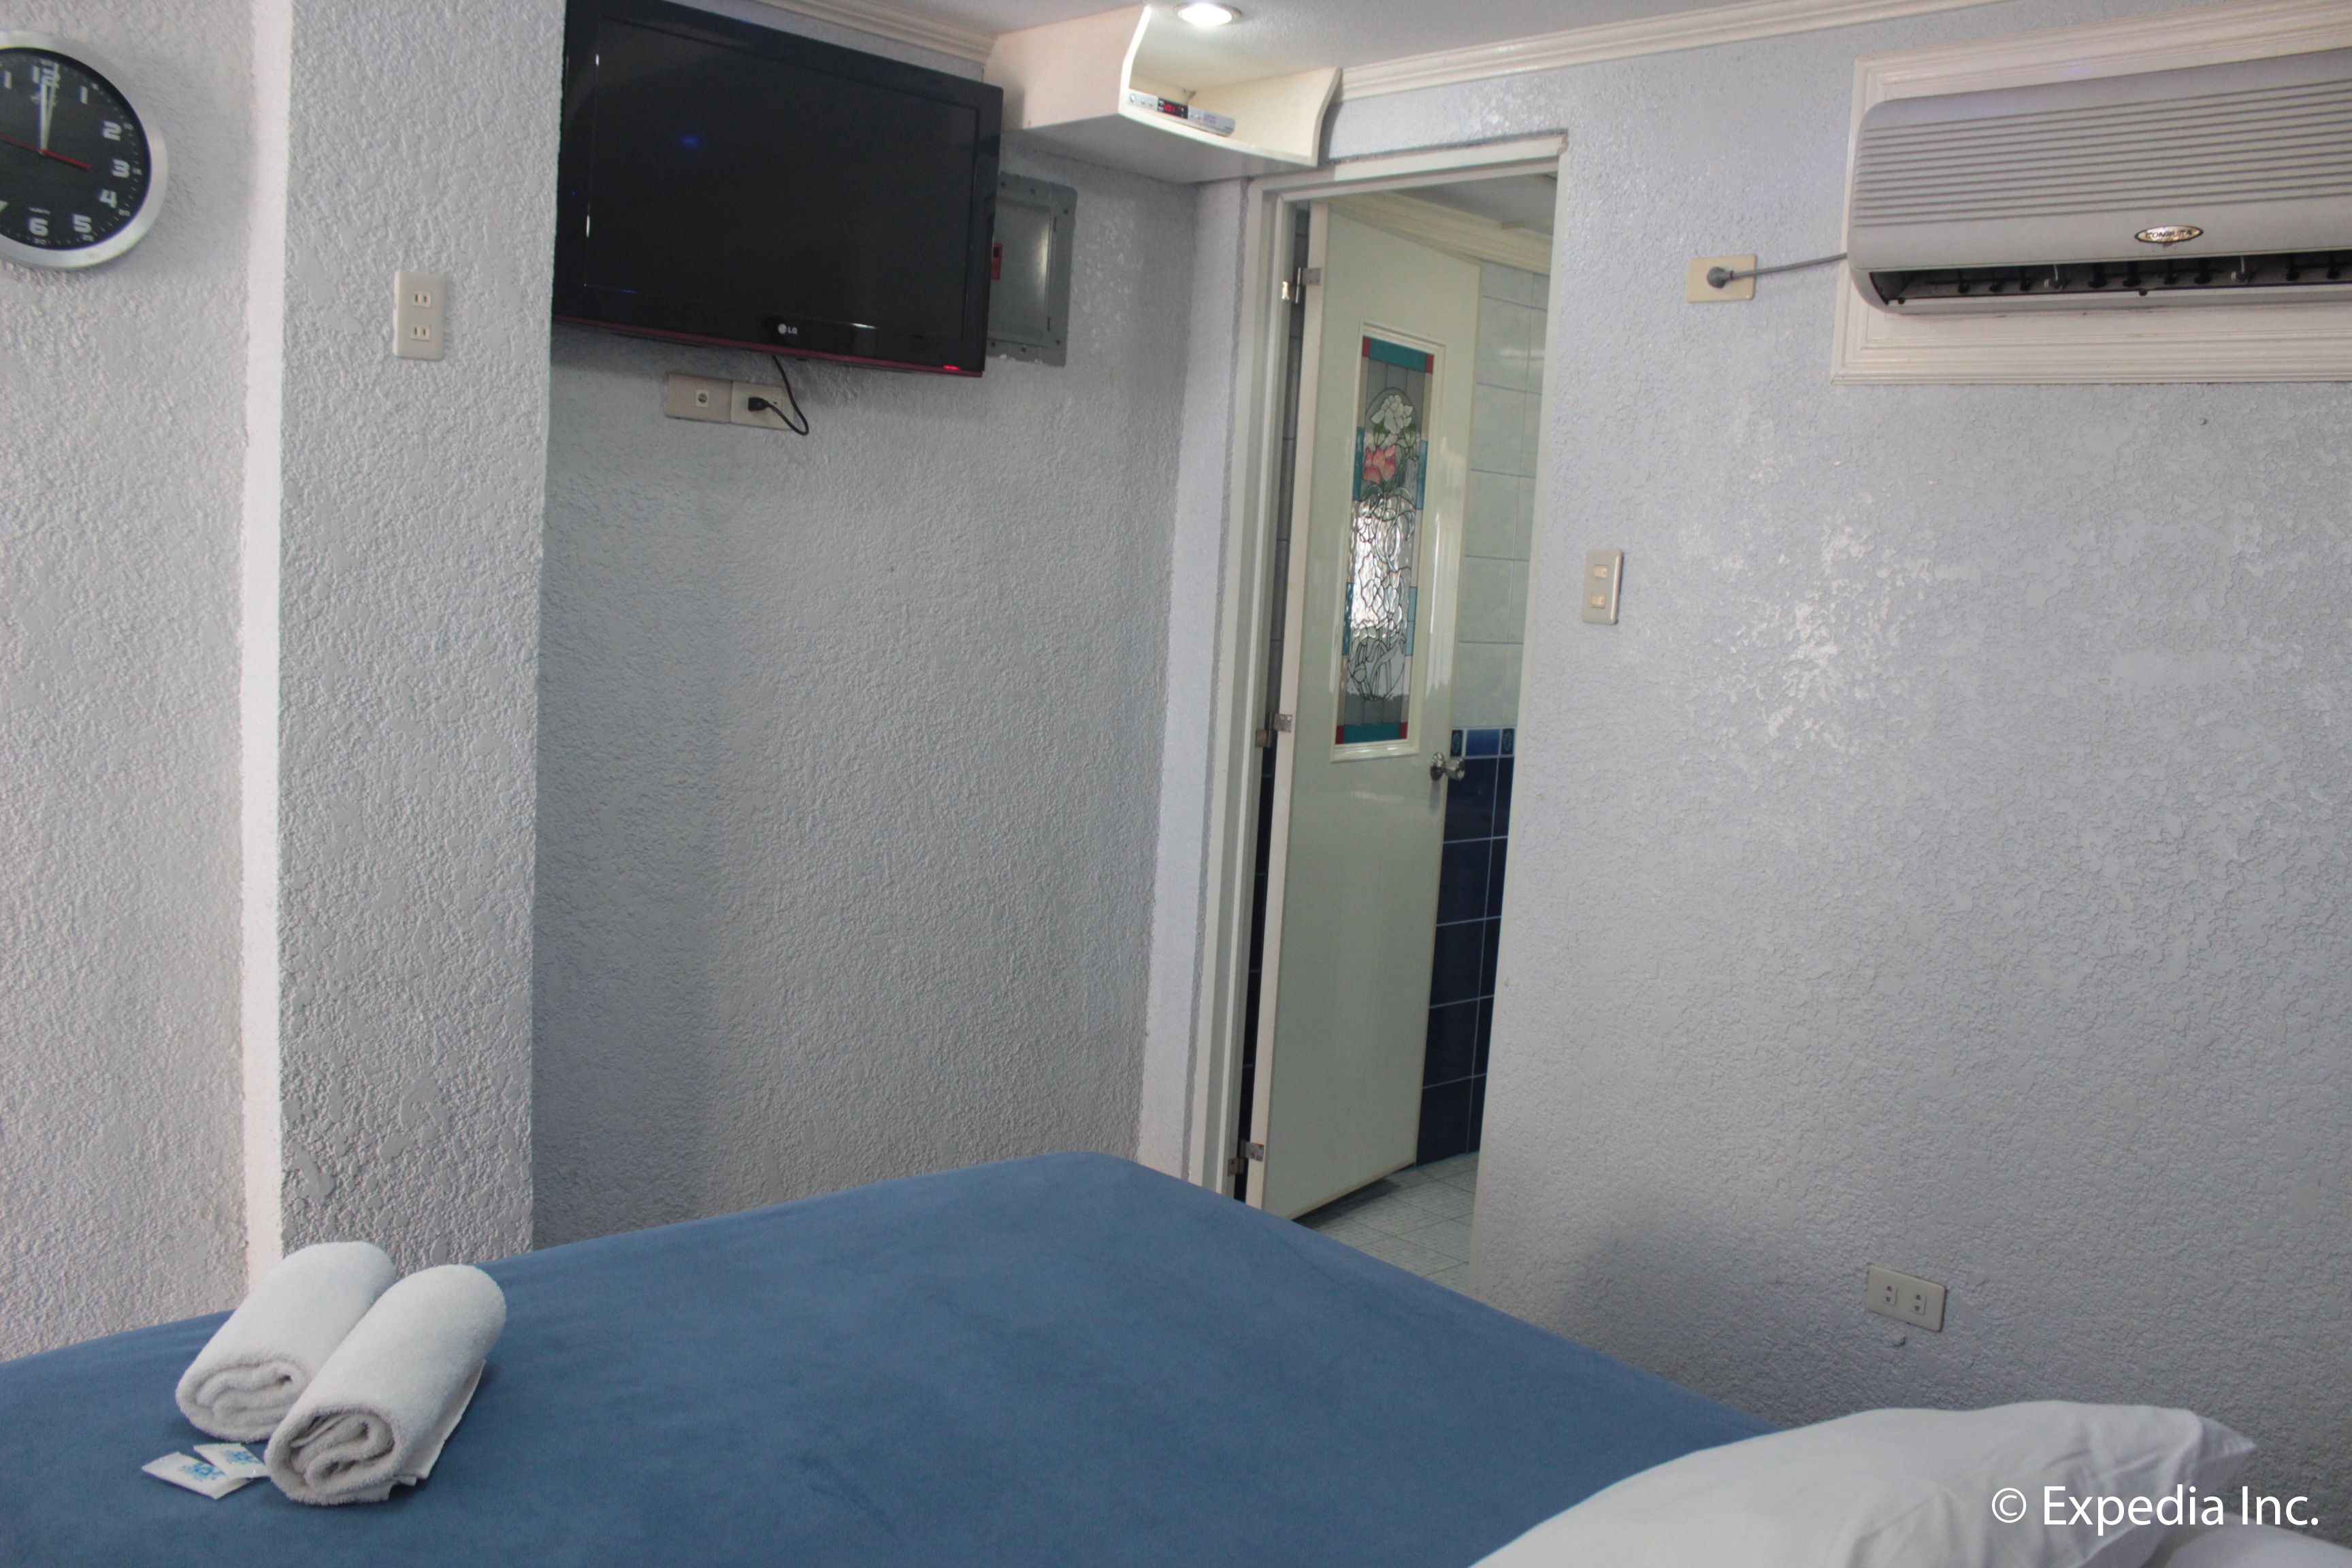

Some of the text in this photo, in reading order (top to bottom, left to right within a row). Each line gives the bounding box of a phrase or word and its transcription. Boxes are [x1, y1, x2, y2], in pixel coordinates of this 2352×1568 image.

[80, 85, 88, 104] 1
[103, 120, 122, 141] 2
[112, 159, 130, 178] 3
[99, 189, 117, 208] 4
[29, 218, 49, 237] 6
[73, 214, 92, 233] 5
[787, 326, 798, 334] LG
